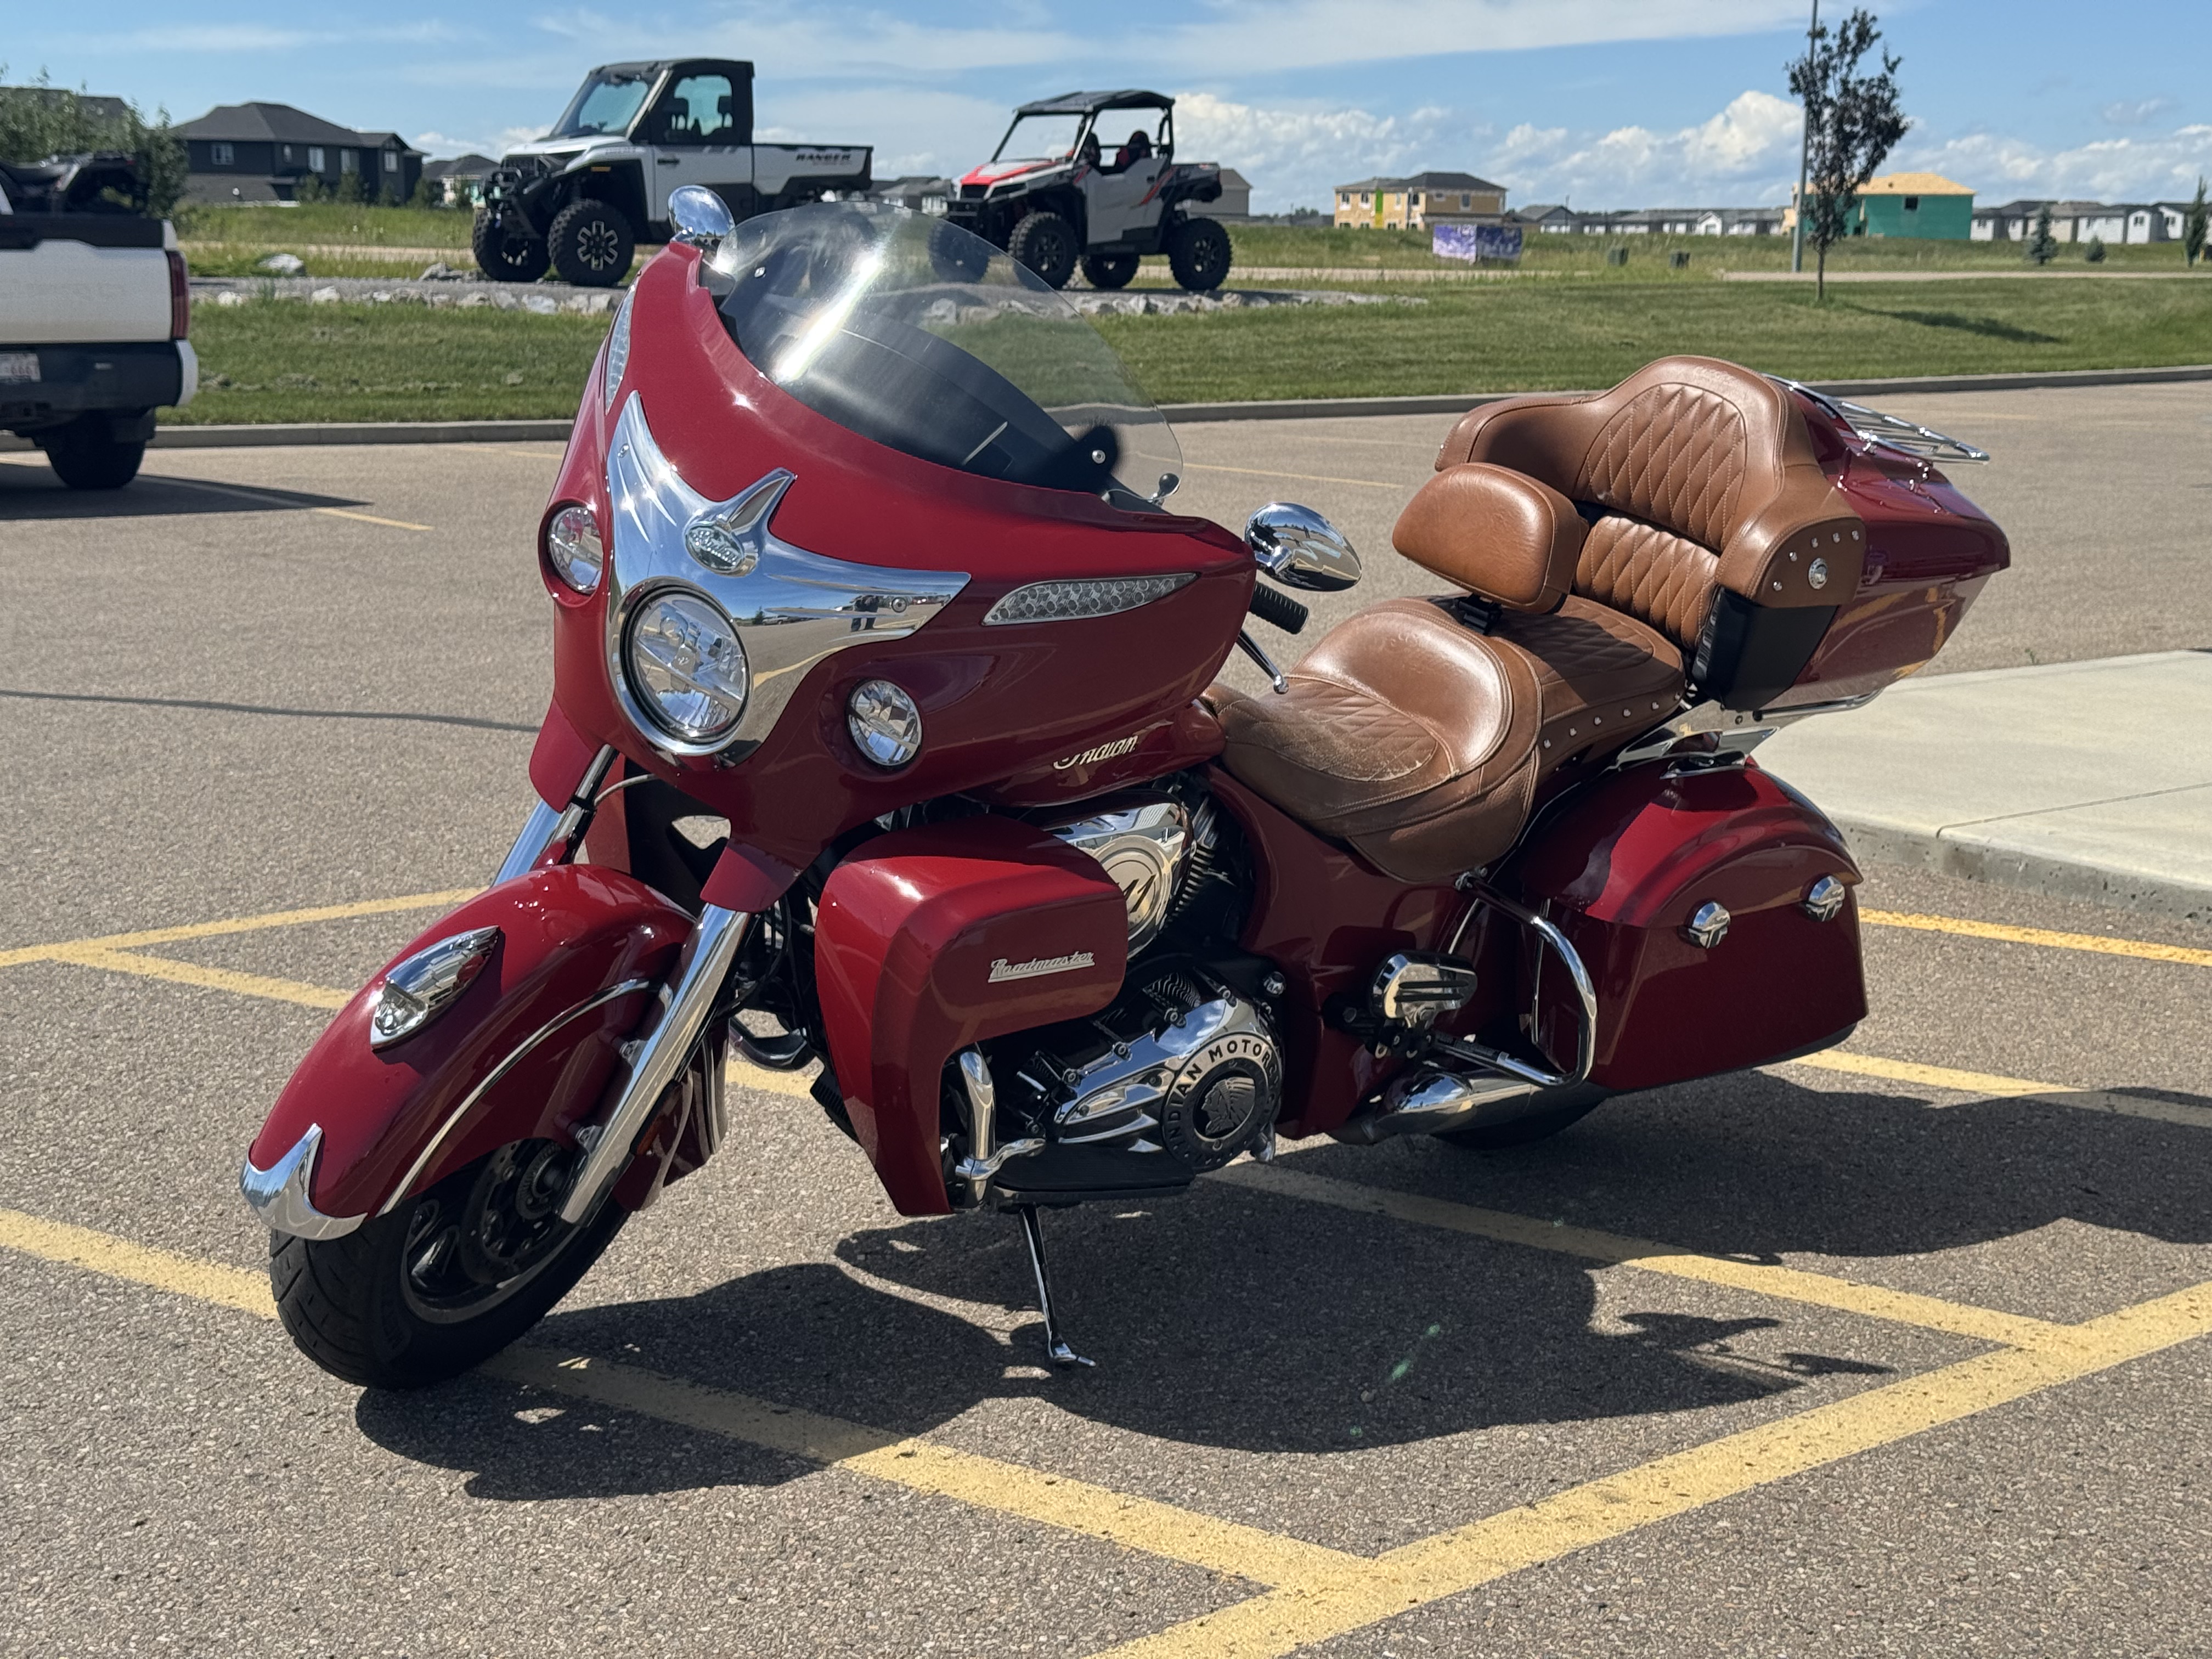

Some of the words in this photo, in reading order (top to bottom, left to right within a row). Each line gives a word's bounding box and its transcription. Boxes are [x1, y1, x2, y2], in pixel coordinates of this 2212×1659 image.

[796, 154, 851, 162] RANGER
[1053, 735, 1138, 770] Indian
[989, 951, 1095, 980] Roadmaster
[1167, 1063, 1203, 1149] INDIAN
